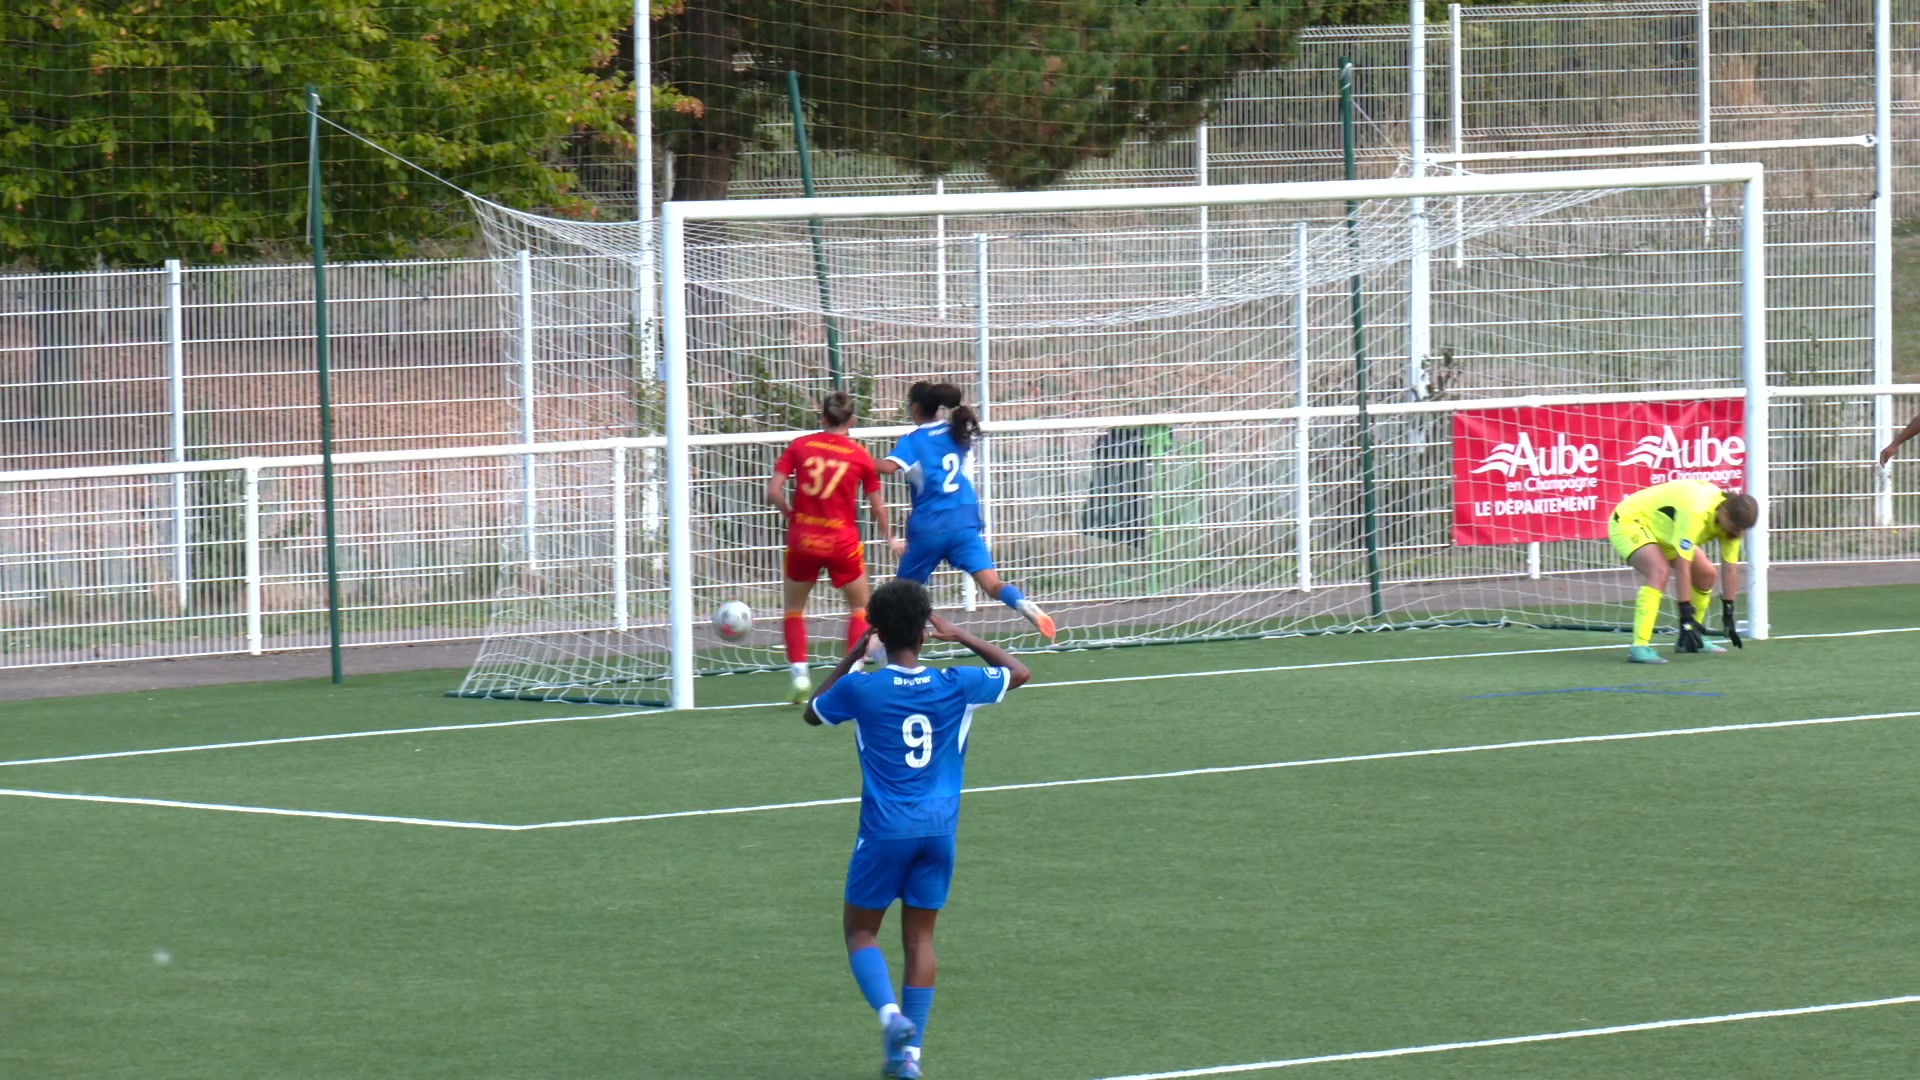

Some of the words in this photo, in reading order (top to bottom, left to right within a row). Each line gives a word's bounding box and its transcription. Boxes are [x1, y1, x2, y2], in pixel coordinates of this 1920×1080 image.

[1508, 431, 1599, 477] Aube
[1651, 425, 1746, 469] Aube
[803, 456, 849, 499] 37
[942, 453, 960, 493] 2
[1506, 481, 1522, 492] en
[1524, 477, 1598, 492] Champagne
[1650, 473, 1666, 484] en
[1475, 501, 1492, 516] LE
[1494, 496, 1598, 516] DÉPARTEMENT
[902, 714, 932, 768] 9
